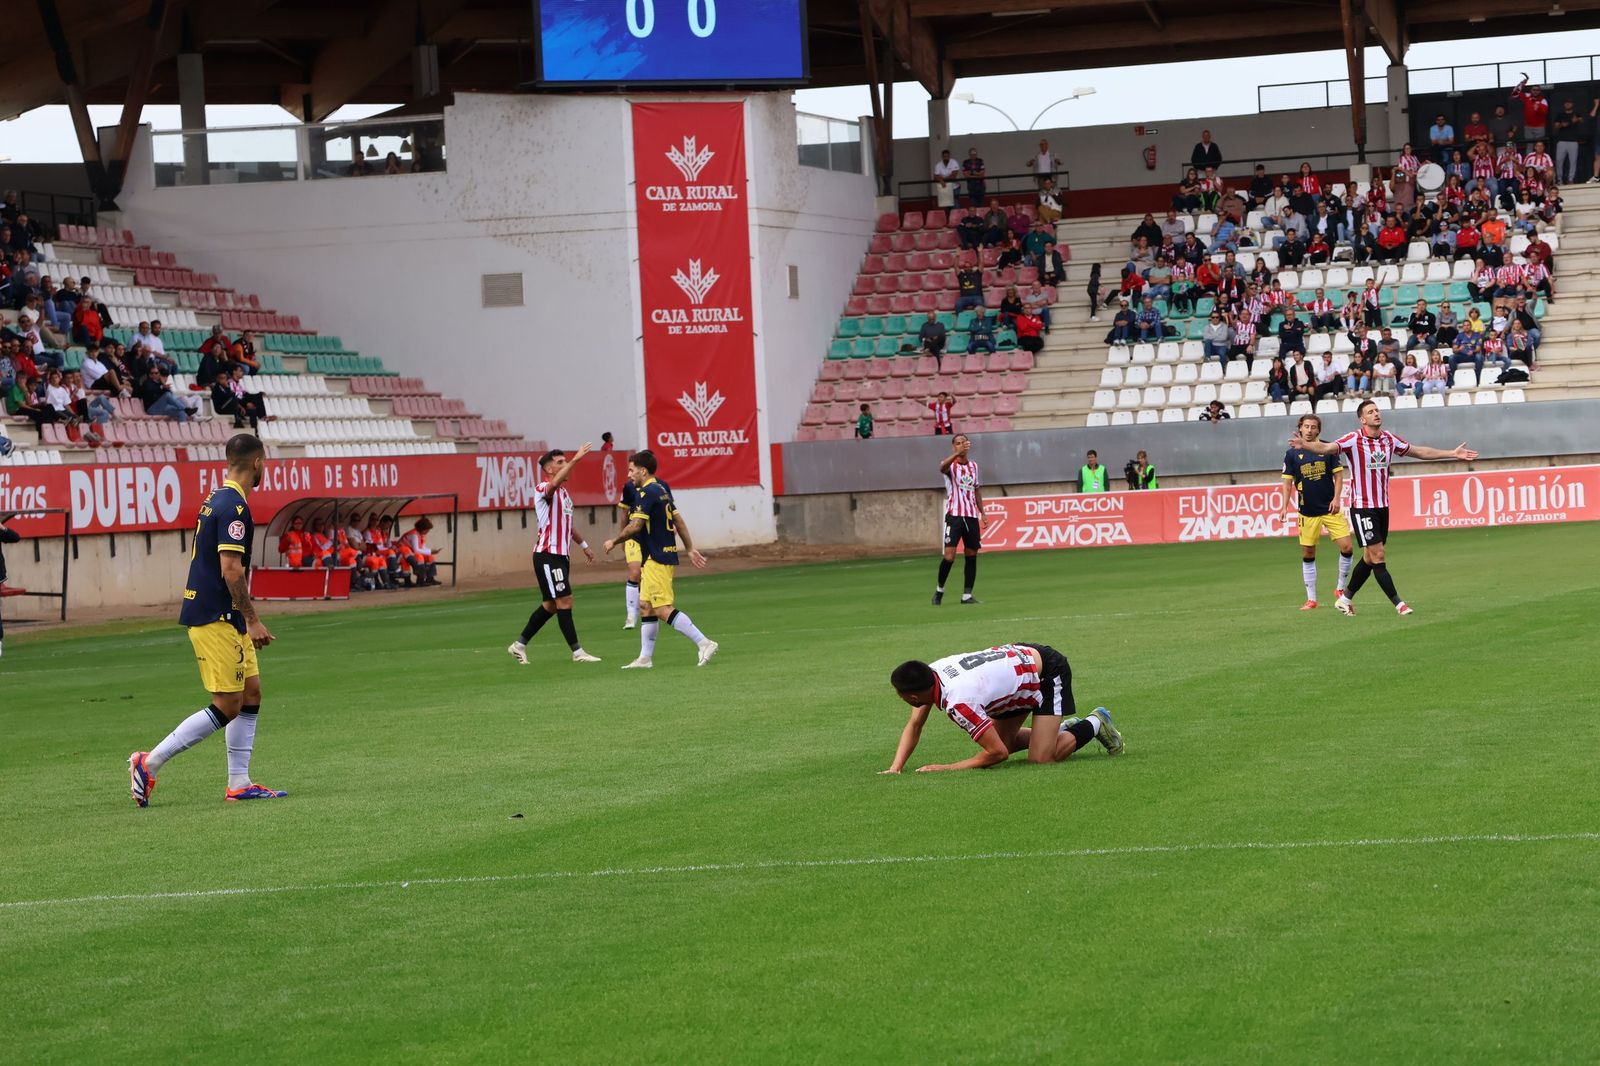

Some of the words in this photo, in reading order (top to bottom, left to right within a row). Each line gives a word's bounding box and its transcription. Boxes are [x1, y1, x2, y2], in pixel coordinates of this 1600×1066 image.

[626, 0, 655, 38] 0
[688, 0, 716, 38] 0
[645, 186, 683, 201] CAJA
[686, 185, 738, 200] RURAL
[662, 203, 676, 212] DE
[679, 202, 722, 212] ZAMORA
[651, 309, 689, 324] CAJA
[692, 307, 744, 323] RURAL
[668, 325, 682, 335] DE
[685, 324, 728, 334] ZAMORA
[657, 432, 694, 447] CAJA
[697, 429, 749, 446] RURAL
[674, 448, 688, 458] DE
[691, 446, 733, 457] ZAMORA
[199, 460, 310, 495] FAACIÓN
[324, 464, 343, 489] DE
[352, 463, 399, 488] STAND
[69, 464, 181, 529] DUERO
[1178, 487, 1300, 515] FUNDACIÓN
[1411, 478, 1451, 517] La
[1462, 474, 1586, 526] Opinión
[1361, 516, 1374, 531] 16
[1425, 516, 1438, 528] El
[1441, 516, 1485, 527] Correo
[1498, 513, 1513, 523] de
[1516, 512, 1567, 523] Zamora
[1015, 522, 1133, 548] ZAMORA
[551, 567, 564, 582] 10
[234, 644, 244, 664] 3
